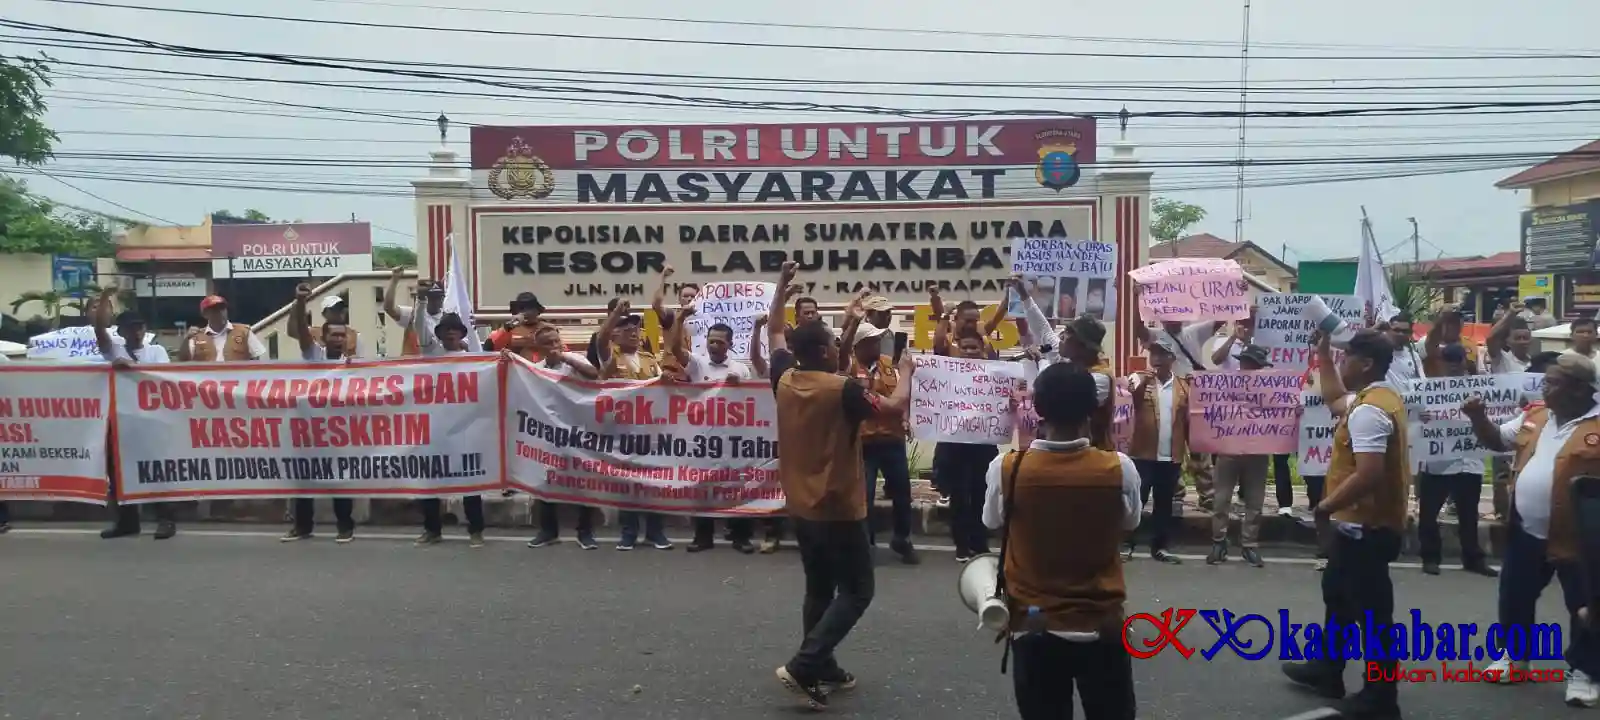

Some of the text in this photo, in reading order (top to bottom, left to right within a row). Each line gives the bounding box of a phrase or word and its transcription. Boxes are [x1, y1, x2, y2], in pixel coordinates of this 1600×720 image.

[574, 125, 1005, 161] POLRI UNTUK
[577, 169, 1006, 203] MASYARAKAT
[502, 219, 1067, 245] KEPOLISIAN DAERAH SUMATERA UTARA
[242, 241, 339, 257] POLRI UNTUK
[1024, 239, 1073, 251] KORBAN
[242, 256, 341, 270] MASYARAKAT
[502, 250, 666, 275] RESOR
[563, 282, 607, 297] JLN.
[613, 282, 644, 296] MH
[695, 283, 765, 300] APOLRES
[702, 301, 743, 314] BATU
[1303, 319, 1317, 332] RA
[137, 371, 479, 411] COPOT KAPOLRES DAN
[918, 379, 952, 394] KAMI
[1413, 377, 1497, 392] KAMI DATANG
[189, 413, 431, 449] KASAT RESKRIM
[516, 410, 615, 453] Terapkan
[619, 432, 723, 459] UU.No.39
[2, 446, 92, 461] KAMI BEKERJA
[515, 440, 570, 471] Tentang
[1429, 440, 1444, 456] DI
[137, 457, 213, 484] KARENA
[215, 456, 281, 481] DIDUGA
[281, 455, 335, 480] TIDAK
